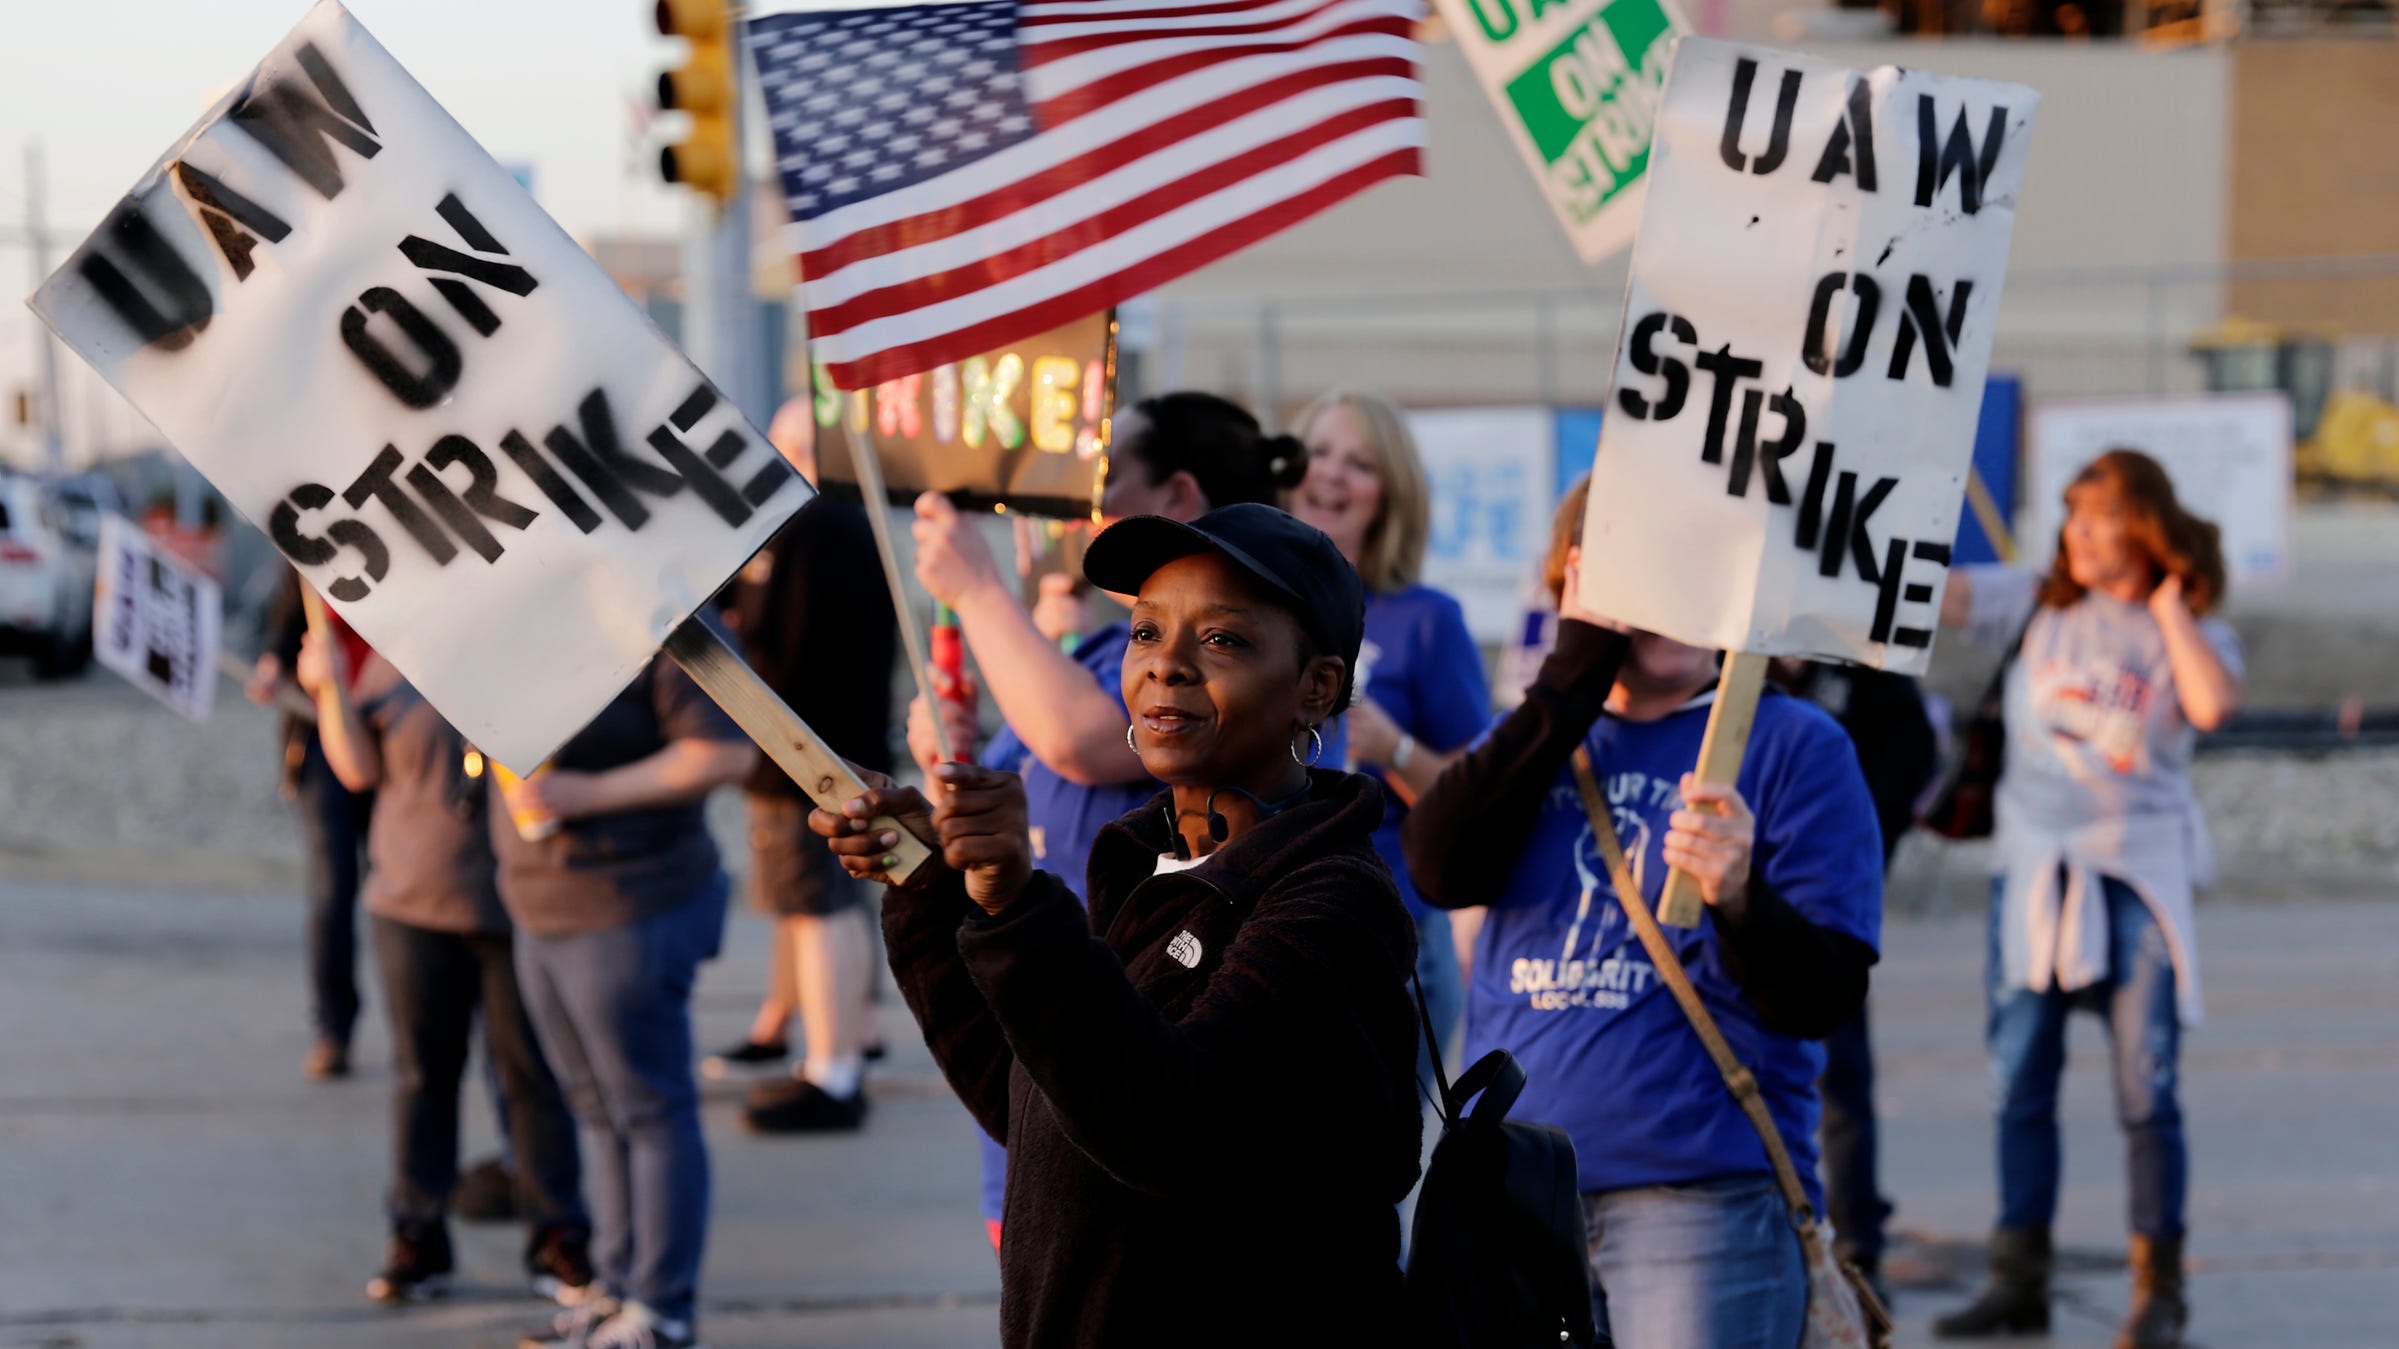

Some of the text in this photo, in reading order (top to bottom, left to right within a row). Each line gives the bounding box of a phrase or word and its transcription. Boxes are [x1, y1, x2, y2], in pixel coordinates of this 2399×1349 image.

[1549, 17, 1626, 120] ON
[1720, 57, 2008, 215] UAW
[78, 40, 383, 354] UAW
[340, 192, 539, 410] ON
[1802, 271, 1975, 388] ON
[268, 383, 793, 603] STRIKE
[1617, 311, 1951, 649] STRIKE
